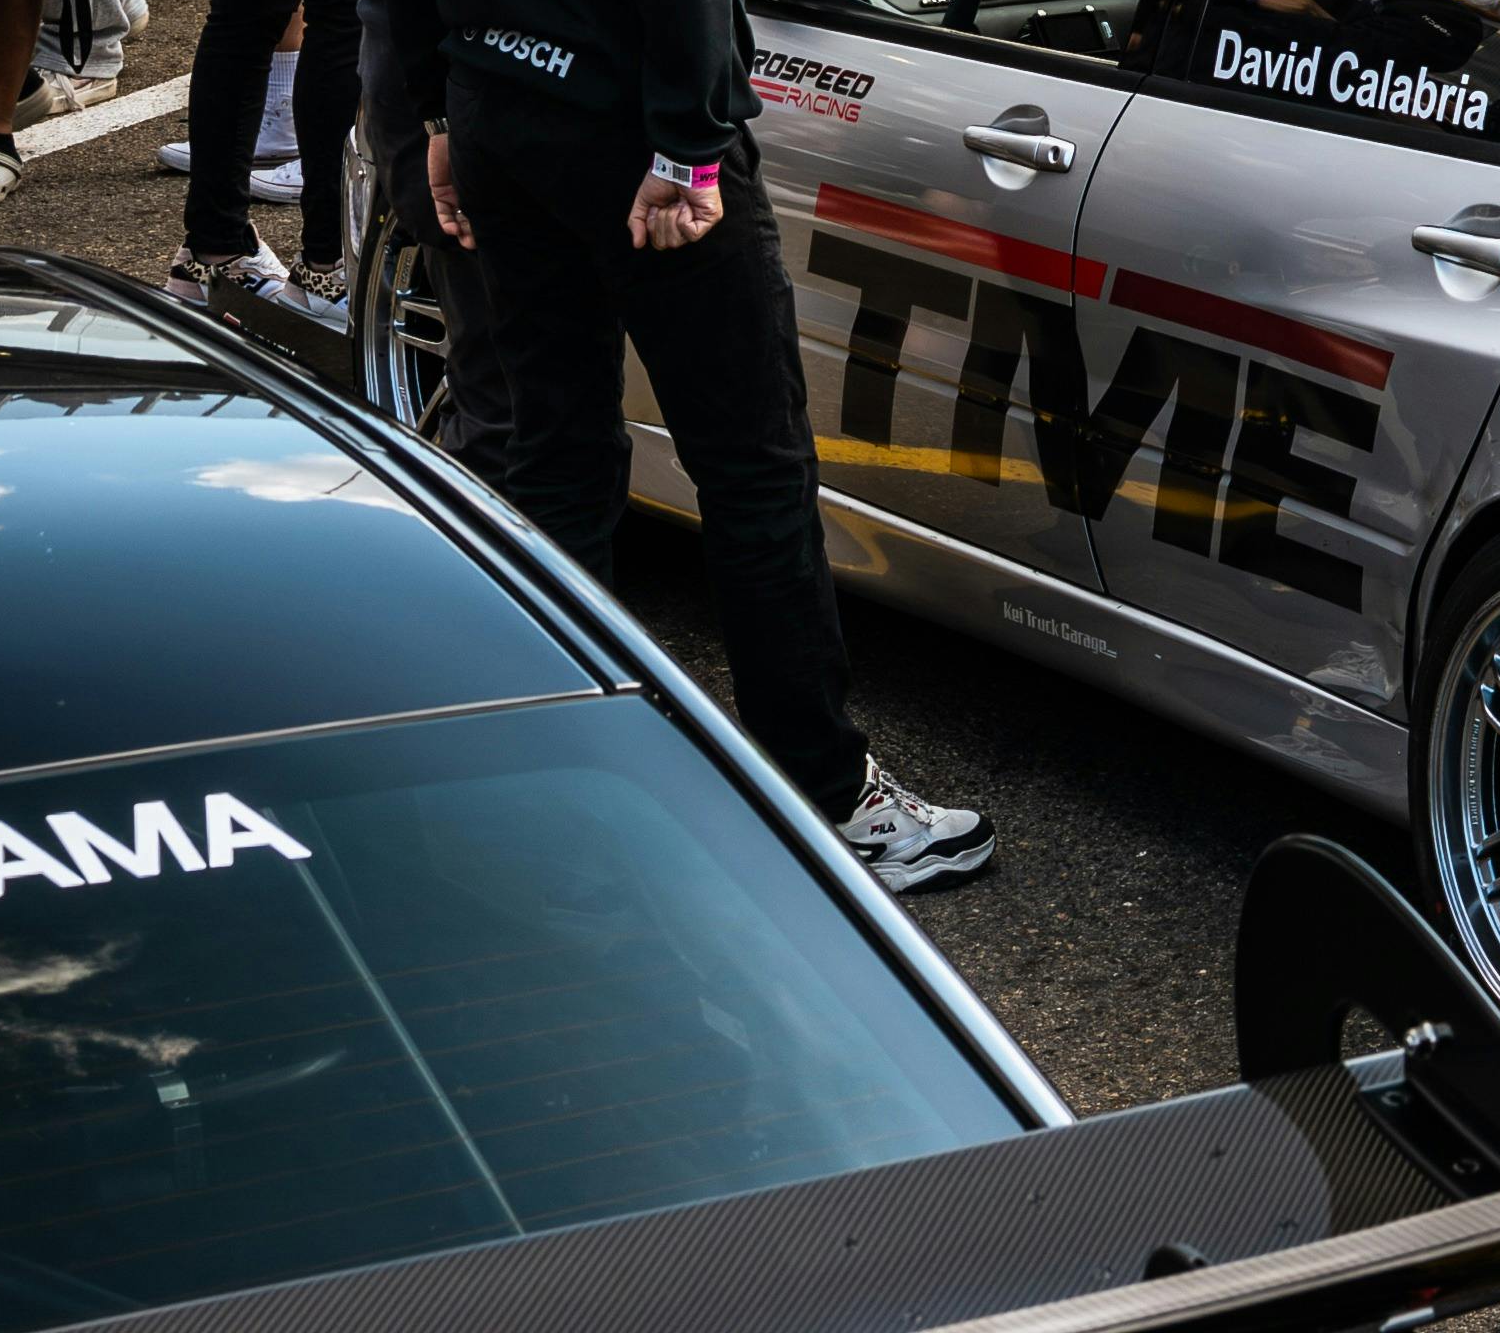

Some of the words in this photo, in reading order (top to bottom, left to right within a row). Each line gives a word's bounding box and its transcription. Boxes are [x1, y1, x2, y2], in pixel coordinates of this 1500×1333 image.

[483, 25, 575, 80] BOSCH
[752, 48, 875, 101] ROSPEED
[783, 89, 862, 124] RACING
[1213, 29, 1318, 99] David
[1329, 52, 1491, 131] Calabria
[806, 229, 1382, 615] TME
[1002, 602, 1023, 625] Kei
[1026, 608, 1058, 638] Truck
